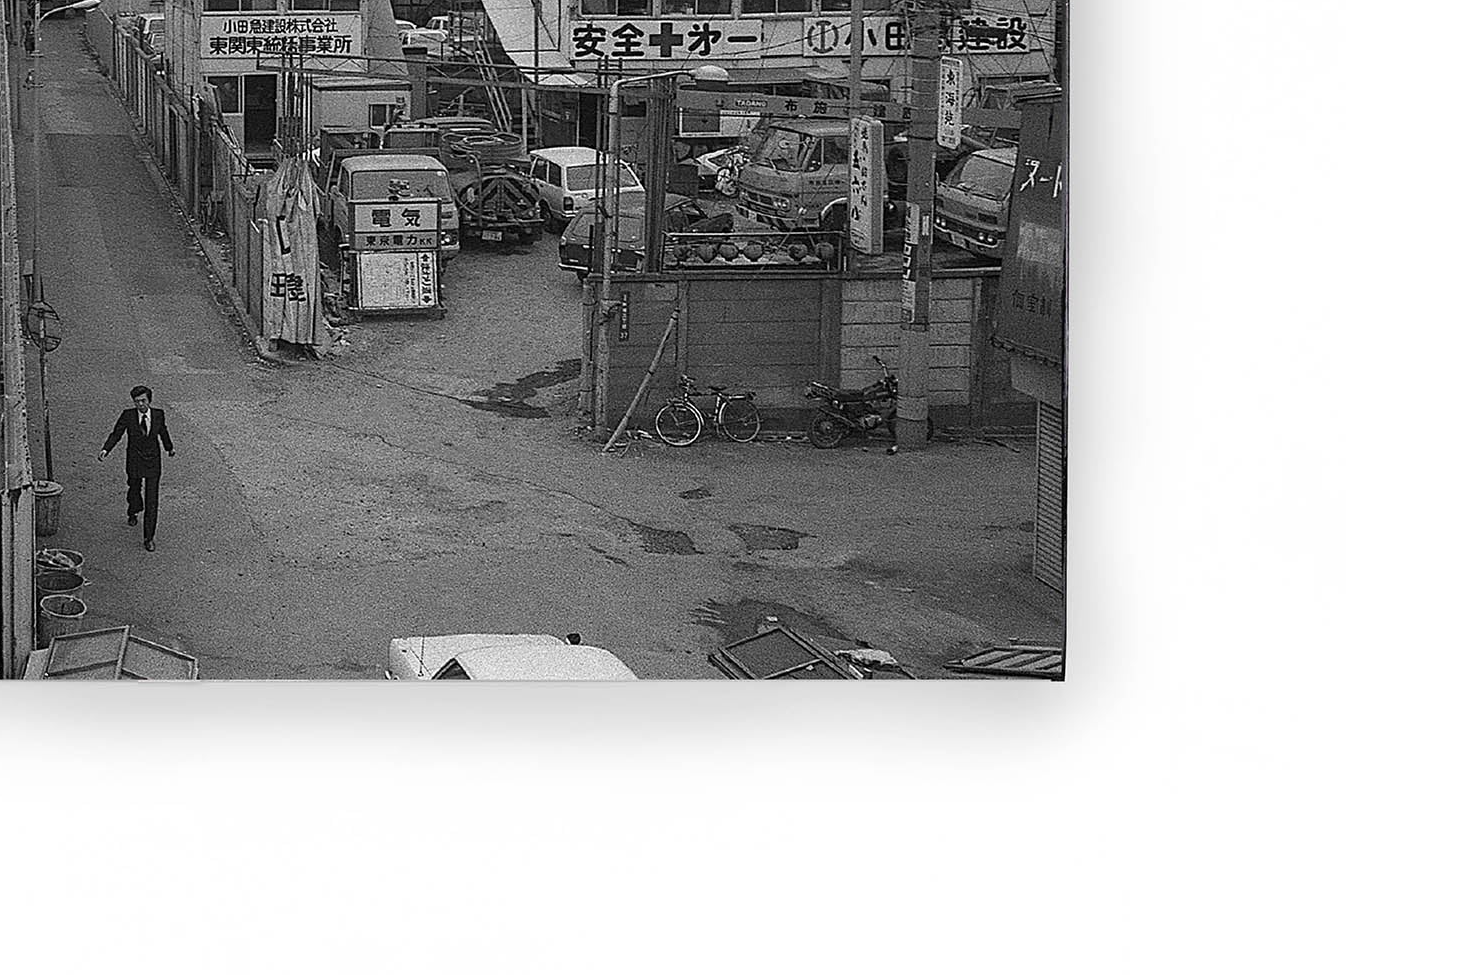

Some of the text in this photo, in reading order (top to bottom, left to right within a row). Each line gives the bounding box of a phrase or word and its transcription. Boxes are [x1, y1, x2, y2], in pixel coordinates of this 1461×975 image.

[223, 17, 339, 35] 小田急建設株式会社
[844, 16, 1028, 52] 小田建設
[209, 34, 353, 56] 東関東統括事業所
[572, 22, 645, 58] 安全
[736, 95, 769, 108] TADANO
[371, 208, 422, 228] 電気
[366, 233, 418, 246] 東京電力
